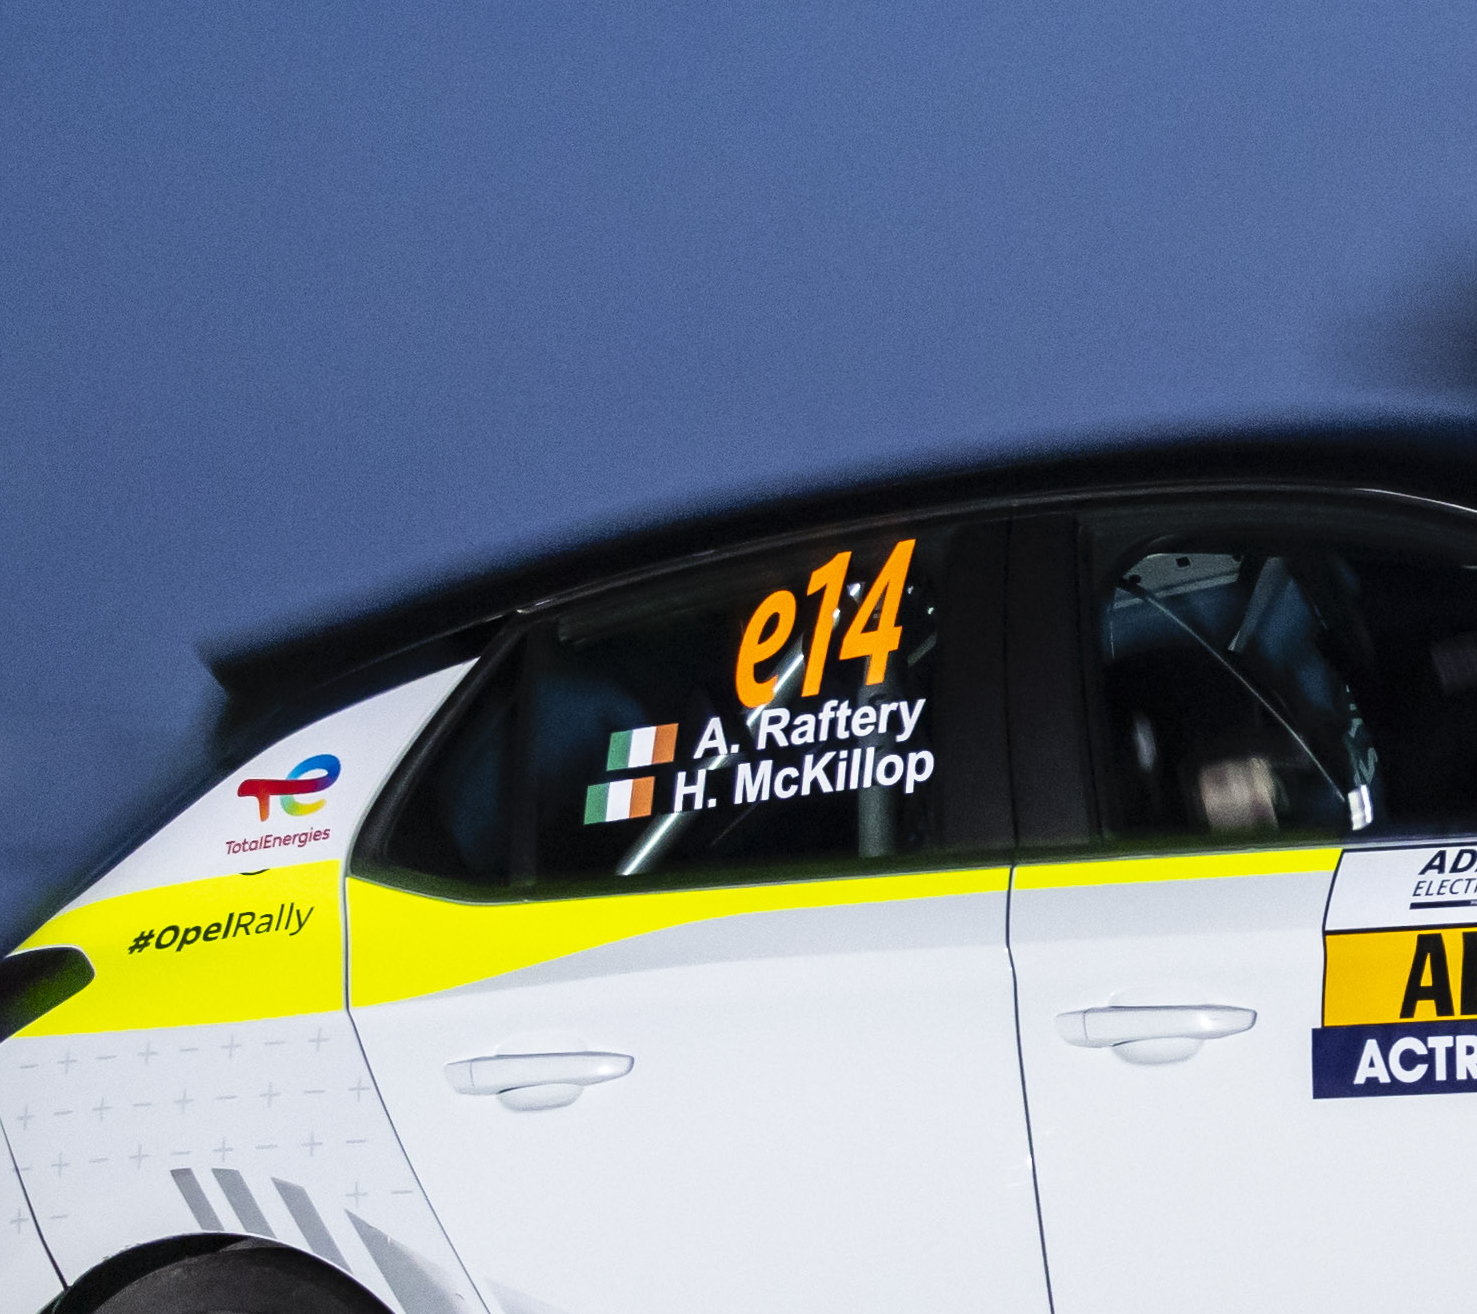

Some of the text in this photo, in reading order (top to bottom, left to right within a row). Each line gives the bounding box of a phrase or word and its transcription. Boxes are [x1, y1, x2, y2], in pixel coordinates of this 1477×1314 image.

[735, 539, 916, 708] e14
[693, 698, 926, 759] A. Raftery
[674, 746, 935, 813] H. McKillop
[225, 827, 331, 855] TotalEnergies
[128, 902, 314, 954] #OpelRally
